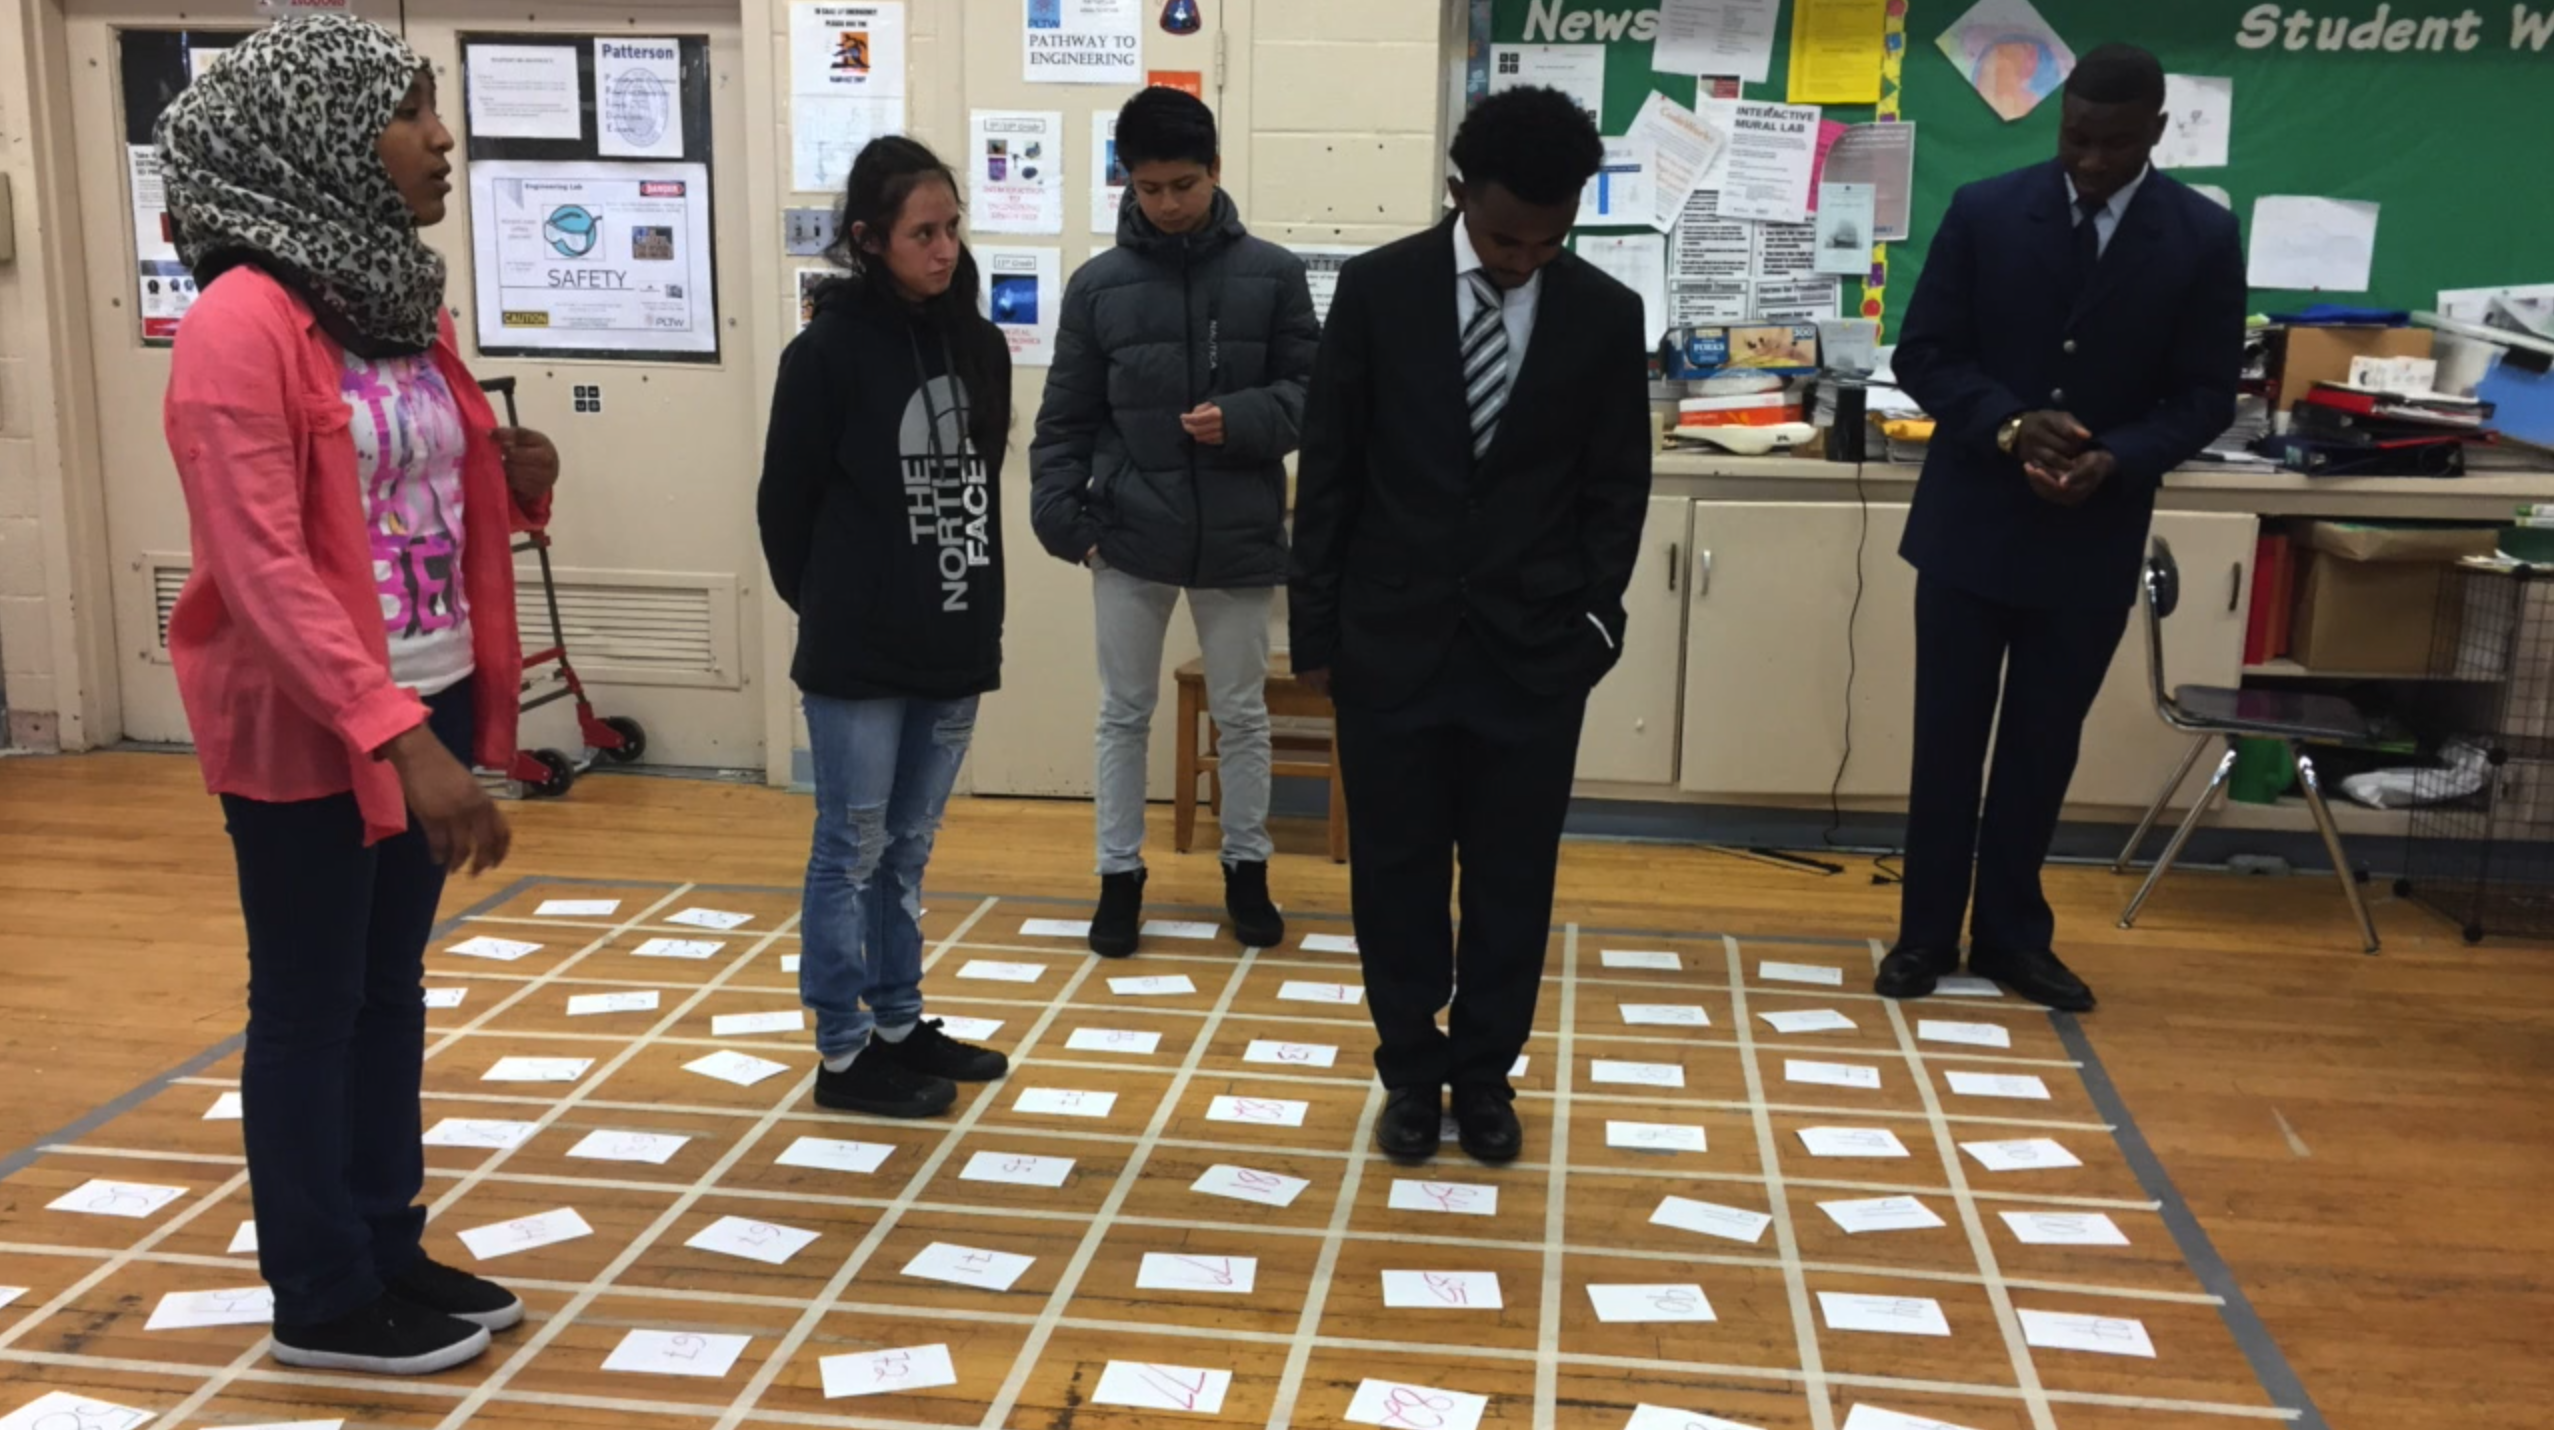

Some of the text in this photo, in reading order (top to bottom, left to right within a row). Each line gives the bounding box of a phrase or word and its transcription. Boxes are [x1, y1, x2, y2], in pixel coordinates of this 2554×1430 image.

[1522, 0, 1660, 42] News
[2235, 2, 2482, 51] Student
[1029, 34, 1136, 48] PATHWAY TO
[602, 44, 674, 60] Patterson
[1030, 52, 1135, 66] ENGINEERING
[1736, 105, 1814, 122] INTERACTIVE
[1734, 119, 1805, 133] MURAL LAB
[525, 183, 567, 192] Engineering
[646, 185, 679, 193] DANGER
[548, 269, 627, 288] SAFETY
[503, 312, 547, 325] CAUTION
[655, 318, 684, 327] PLTW
[1209, 319, 1218, 369] NAUTICA
[1693, 343, 1725, 351] FORKS
[901, 457, 937, 544] THE
[961, 459, 990, 566] FACE
[930, 457, 968, 612] NORTH
